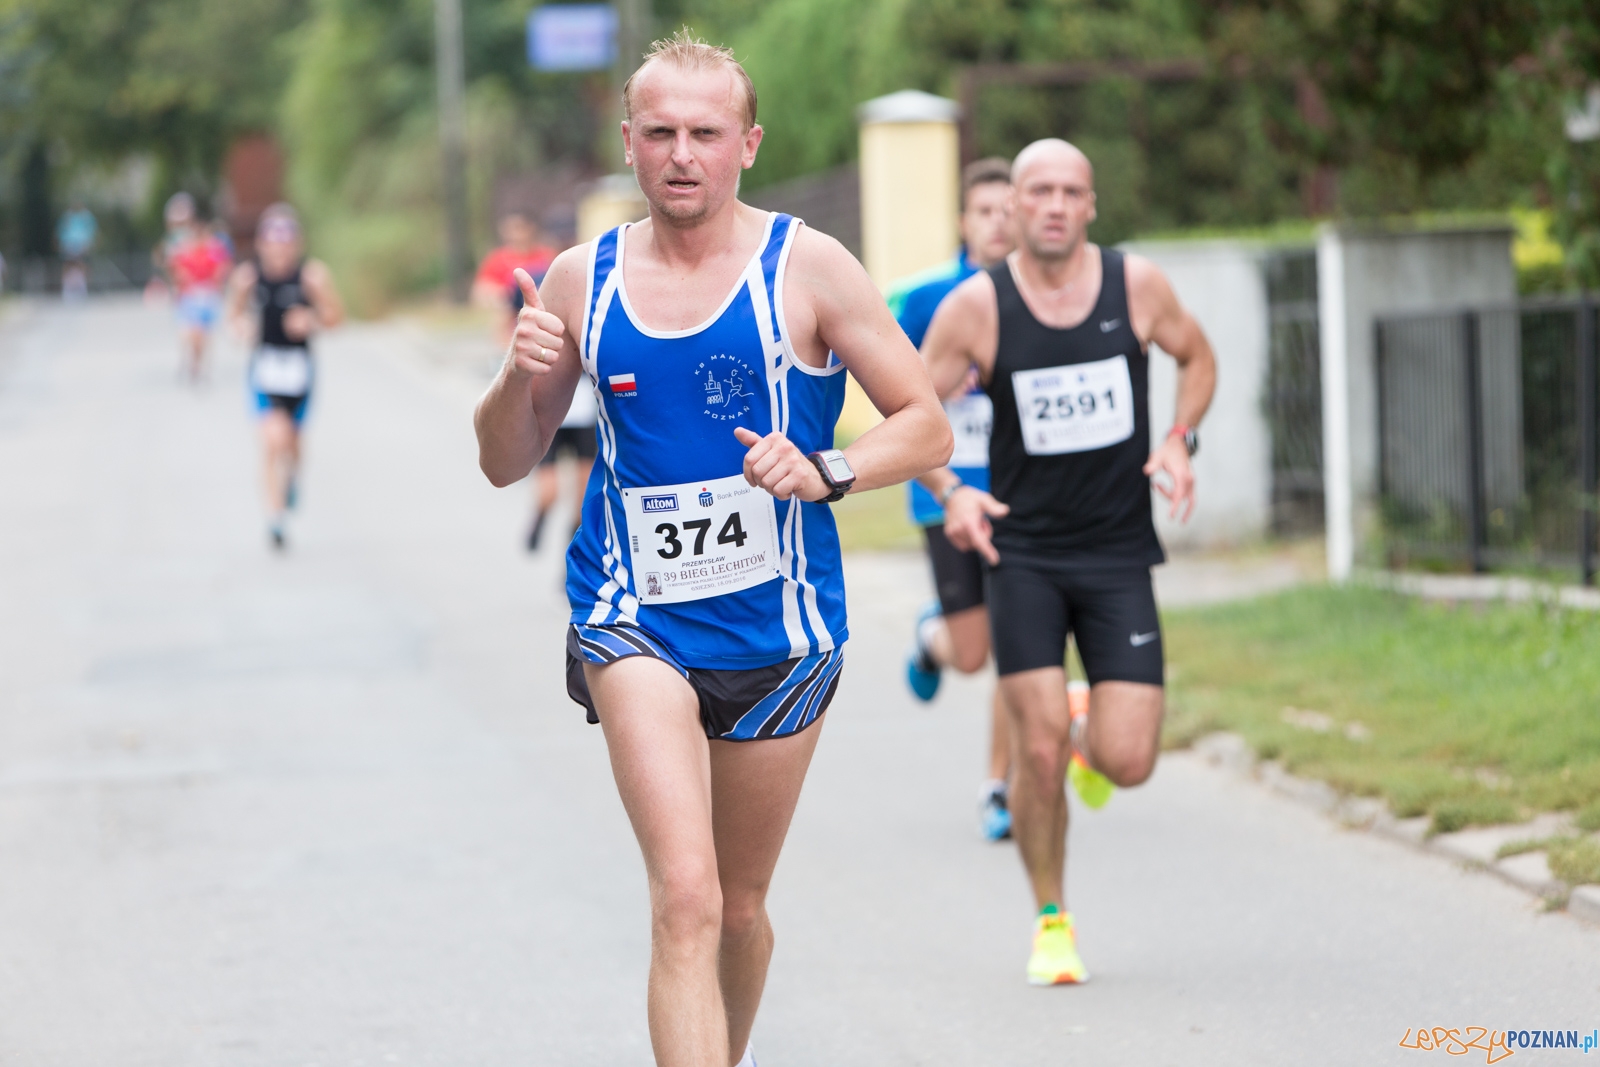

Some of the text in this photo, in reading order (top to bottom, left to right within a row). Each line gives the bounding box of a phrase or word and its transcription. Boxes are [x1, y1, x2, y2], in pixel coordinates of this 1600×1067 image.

[694, 353, 754, 376] KB MANIAC
[1034, 388, 1115, 421] 2591
[717, 487, 751, 501] Bank Polski
[655, 511, 748, 560] 374
[663, 571, 678, 582] 39
[680, 567, 709, 580] BIEG
[711, 550, 766, 575] LECHITÓW
[681, 555, 726, 568] PRZEMYSŁAW
